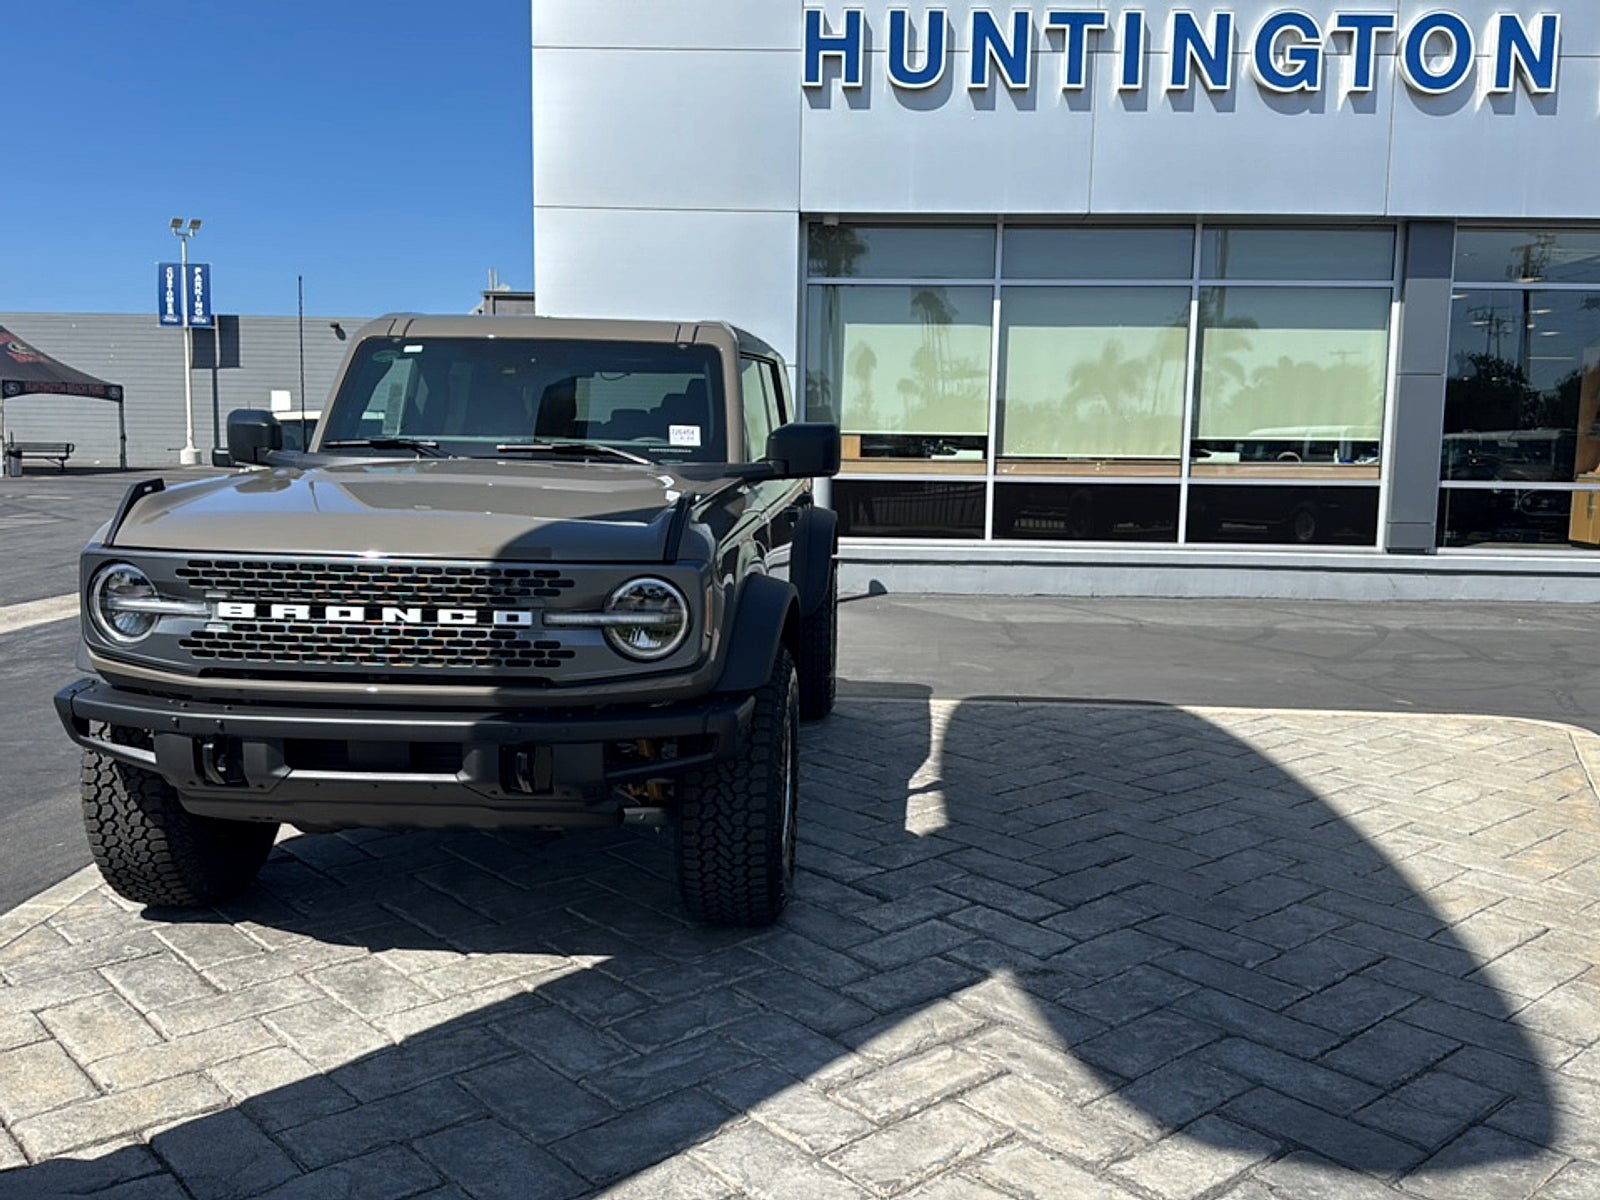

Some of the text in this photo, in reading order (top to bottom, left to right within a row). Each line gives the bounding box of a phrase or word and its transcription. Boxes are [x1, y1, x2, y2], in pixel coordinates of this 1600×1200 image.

[801, 7, 1562, 96] HUNTINGTON
[166, 266, 175, 315] CUSTOMER
[194, 266, 204, 316] PARKING
[217, 601, 533, 626] BRONCO
